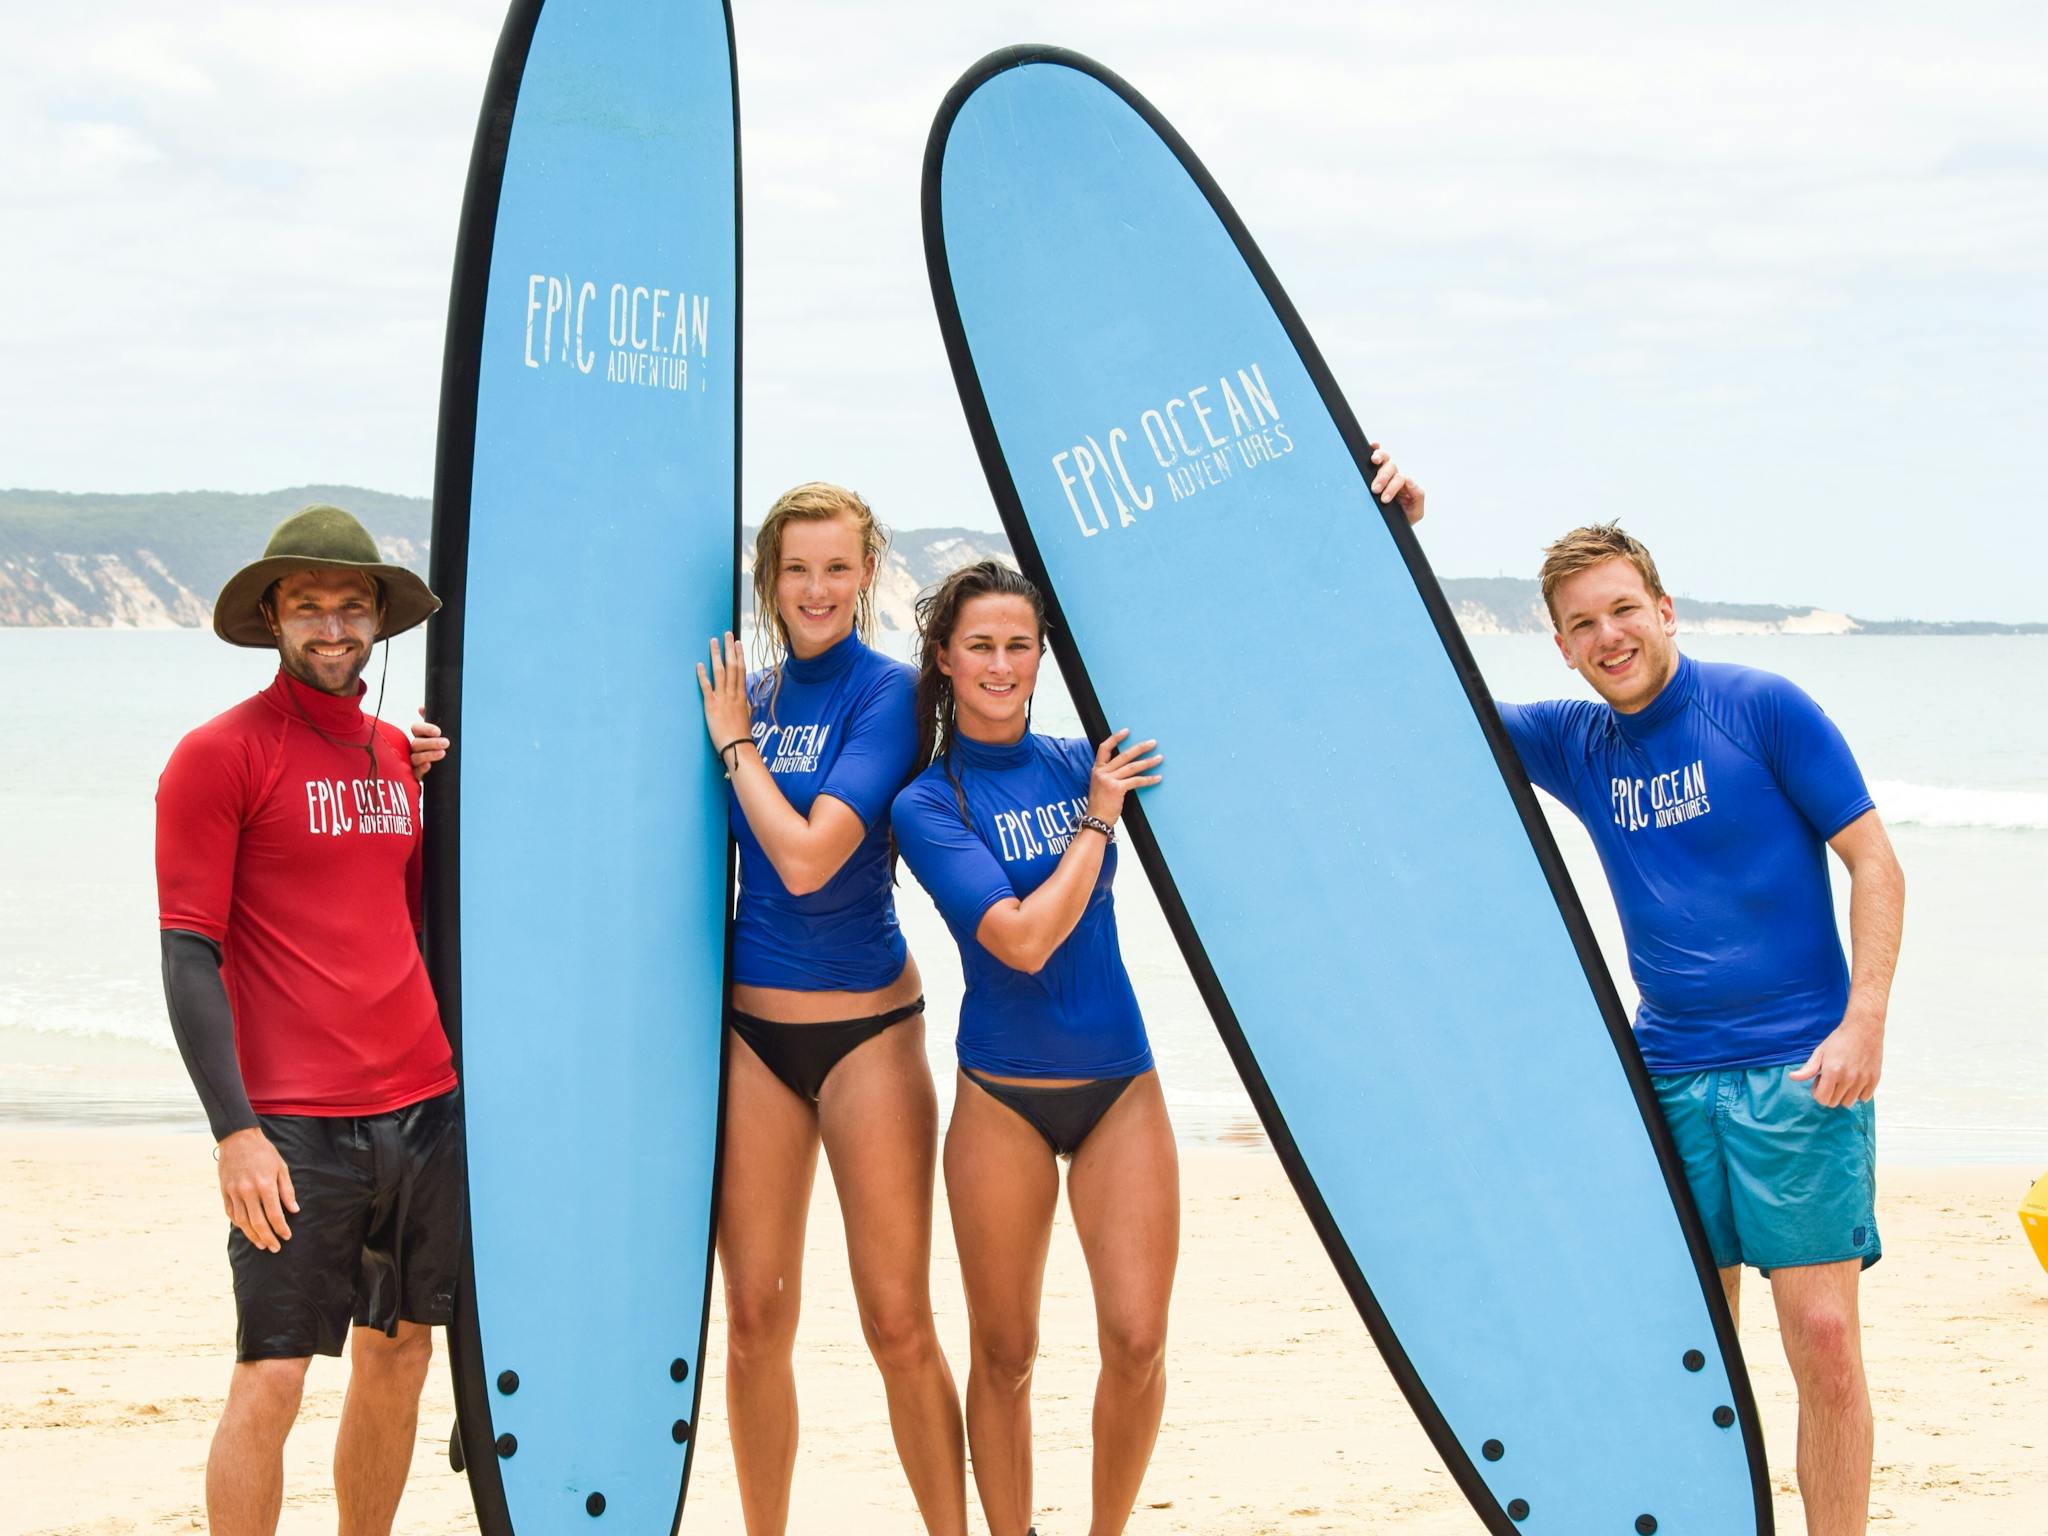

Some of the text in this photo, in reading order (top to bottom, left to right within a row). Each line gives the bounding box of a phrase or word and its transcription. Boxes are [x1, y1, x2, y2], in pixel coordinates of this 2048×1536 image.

[525, 272, 710, 375] EPIC OCEAN
[607, 350, 707, 392] ADVENTUR
[1052, 363, 1281, 538] EPIC OCEAN
[1166, 423, 1295, 503] ADVENTURES
[776, 724, 831, 757] OCEAN
[305, 777, 411, 837] EPIC OCEAN
[1611, 760, 1707, 832] EPIC OCEAN
[1655, 795, 1711, 829] ADVENTURES
[359, 814, 413, 836] ADVENTURES
[994, 809, 1043, 862] EPIC
